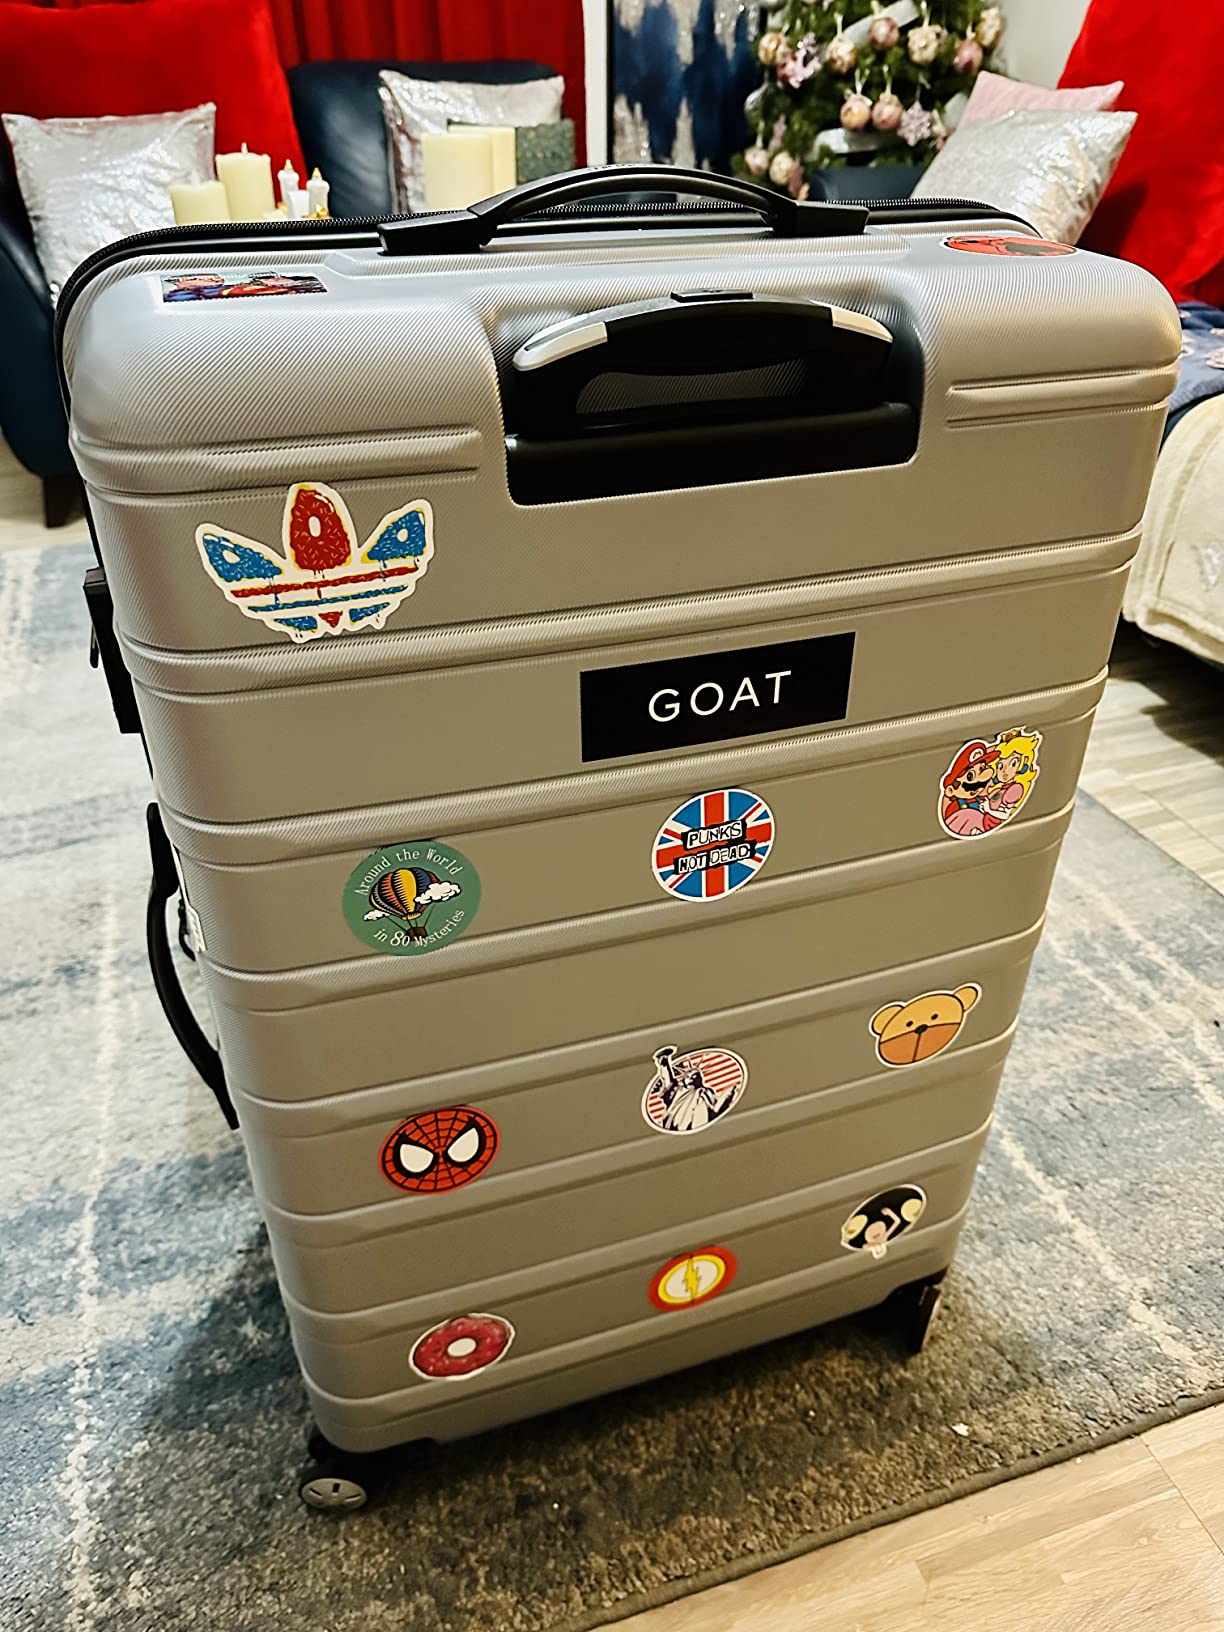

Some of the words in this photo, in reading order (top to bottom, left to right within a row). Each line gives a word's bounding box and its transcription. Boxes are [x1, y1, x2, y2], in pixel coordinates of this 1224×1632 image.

[648, 670, 792, 722] GOAT
[354, 856, 391, 897] Around
[396, 849, 420, 862] the
[426, 848, 463, 876] World
[710, 844, 752, 865] DEAD
[373, 928, 388, 942] in
[390, 930, 410, 947] 80
[414, 909, 465, 947] Mysteries
